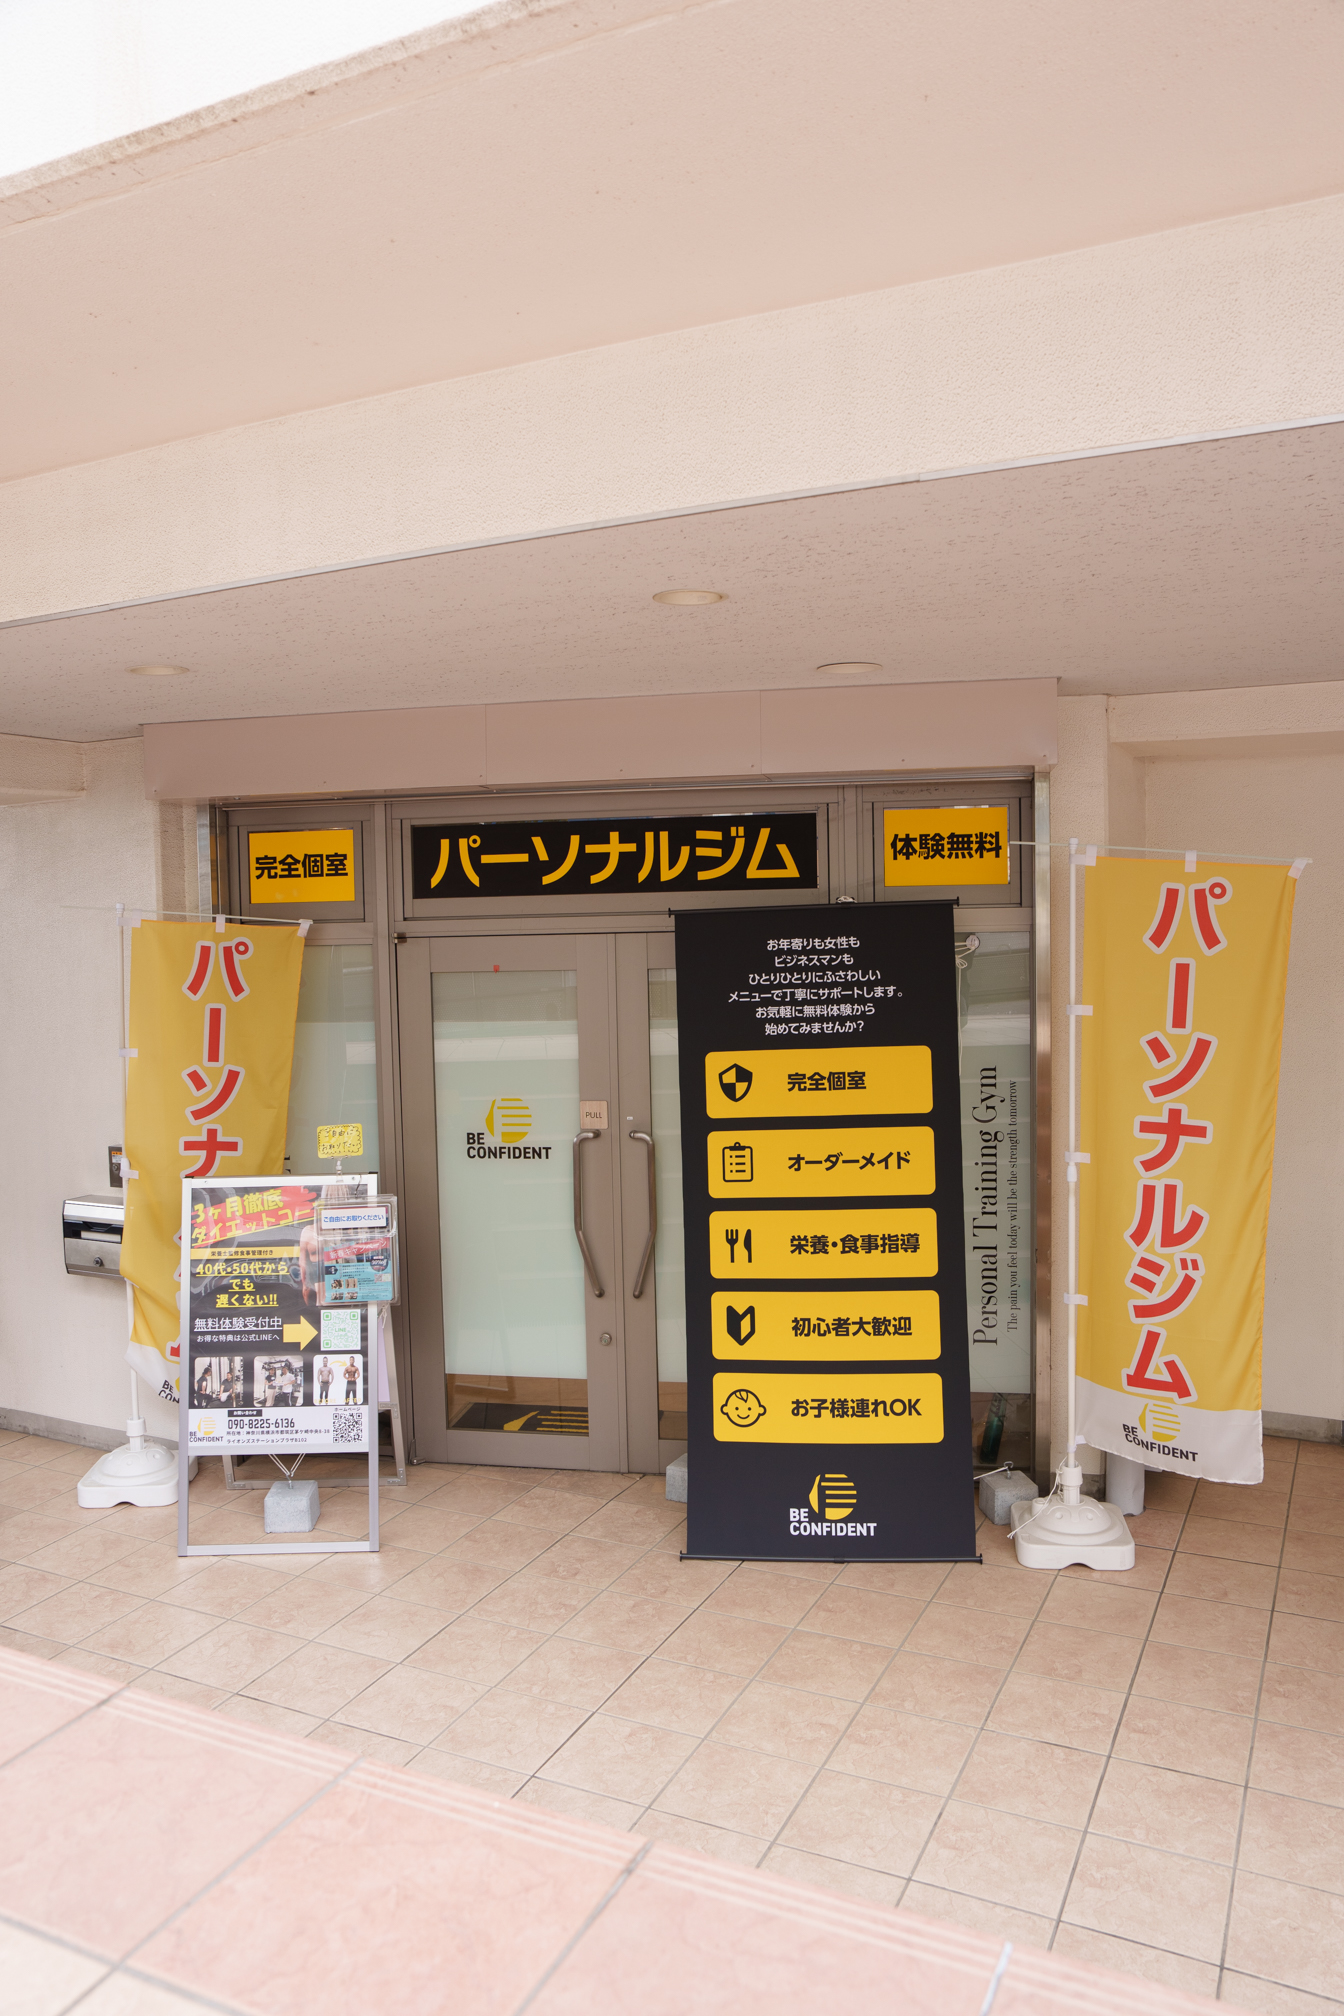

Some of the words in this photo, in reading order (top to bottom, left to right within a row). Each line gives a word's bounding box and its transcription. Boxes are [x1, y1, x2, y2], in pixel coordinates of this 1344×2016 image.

[890, 831, 1002, 861] 体験無料
[431, 826, 800, 889] パーソナルジム
[255, 853, 348, 880] 完全個室
[767, 936, 860, 951] お年寄りも女性も
[774, 953, 854, 967] ビジネスマンも
[749, 970, 881, 985] ひとりひとりにふさわしい
[728, 986, 903, 1003] メニューで丁寧にサポートします。
[755, 1003, 875, 1018] お気軽に無料体験から
[765, 1020, 865, 1035] 始めてみませんか?
[181, 939, 251, 1177] パーソナ
[787, 1070, 866, 1092] 完全個室
[972, 1064, 1005, 1123] Gym
[1007, 1079, 1018, 1126] tomorrow
[585, 1111, 602, 1119] PULL
[466, 1132, 485, 1145] BE
[1124, 880, 1229, 1401] パーソナルジム
[466, 1146, 552, 1159] CONFIDENT
[1006, 1129, 1020, 1168] strength
[787, 1150, 911, 1171] オーダーメイド
[972, 1130, 1005, 1238] Training
[1007, 1170, 1018, 1185] the
[1007, 1188, 1018, 1200] be
[323, 1214, 384, 1222] ご自由にお取りください
[1007, 1202, 1018, 1221] will
[191, 1202, 324, 1243] ダイエットコー
[790, 1233, 920, 1254] 栄養・食事指導
[1007, 1223, 1021, 1249] today
[1007, 1252, 1018, 1268] feel
[229, 1278, 254, 1290] でも
[1010, 1270, 1021, 1287] you
[972, 1245, 998, 1346] Personal
[1008, 1290, 1021, 1311] pain
[194, 1316, 282, 1330] 無料体験受付中
[791, 1316, 912, 1337] 初心者大歓迎
[1007, 1313, 1018, 1332] The
[197, 1334, 280, 1343] お得な特典は公式LINEへ
[162, 1379, 174, 1394] BE
[791, 1398, 922, 1418] お子様連れOK
[227, 1418, 295, 1429] 090-8225-6136
[1122, 1423, 1138, 1437] BE
[1125, 1433, 1198, 1462] CONFIDENT
[789, 1508, 809, 1522] BE
[789, 1522, 877, 1537] CONFIDENT
